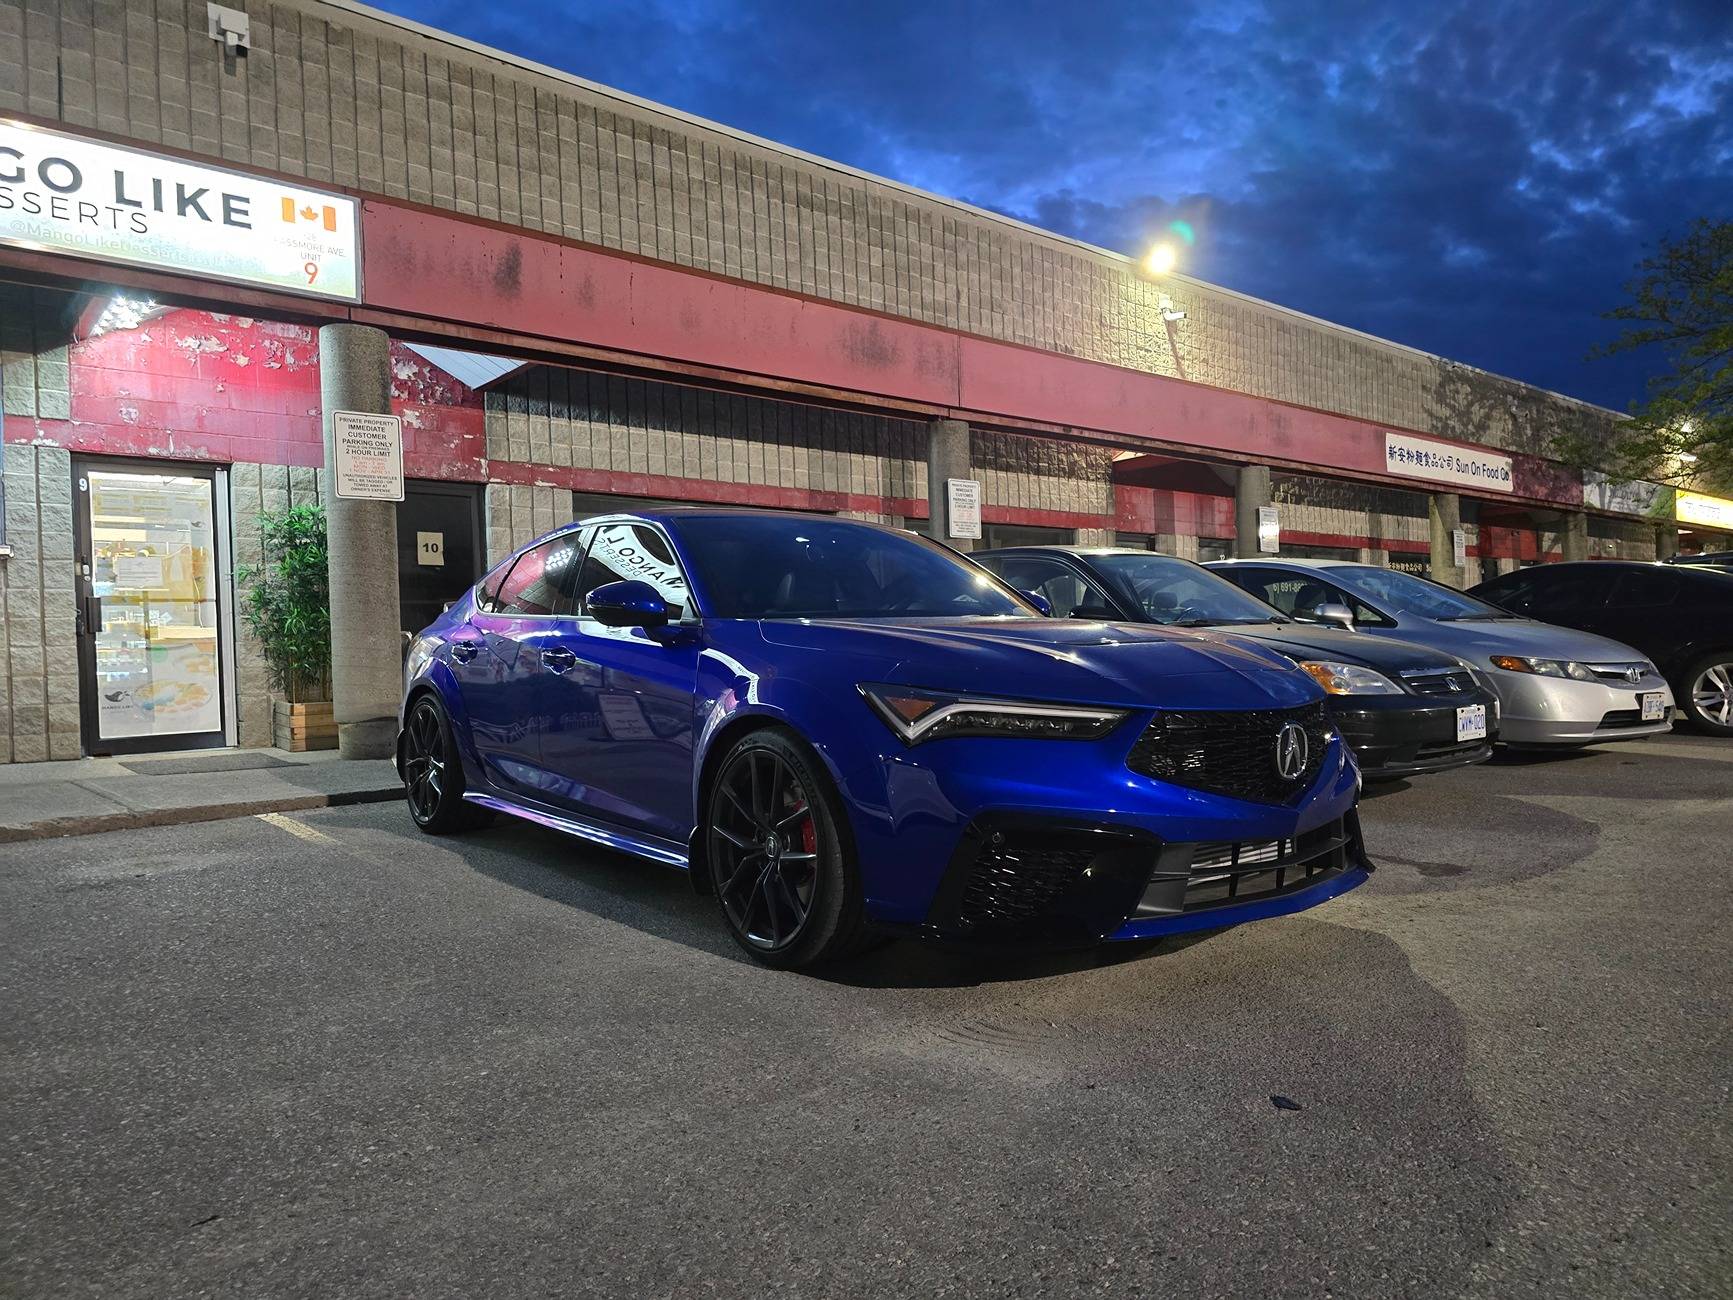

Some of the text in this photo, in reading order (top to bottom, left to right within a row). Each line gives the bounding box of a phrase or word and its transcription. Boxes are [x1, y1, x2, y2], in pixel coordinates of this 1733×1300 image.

[0, 146, 253, 230] GO LIKE
[0, 186, 148, 234] SSERTS
[300, 251, 321, 262] UNIT
[304, 262, 319, 285] 9
[339, 416, 362, 424] PRIVATE
[348, 424, 386, 432] IMMEDIATE
[348, 431, 387, 440] CUSTOMER
[342, 438, 373, 446] PARKING
[1456, 458, 1470, 474] Sun
[1471, 461, 1481, 476] On
[1482, 464, 1499, 480] Food
[79, 478, 88, 491] 9
[423, 543, 439, 553] 10
